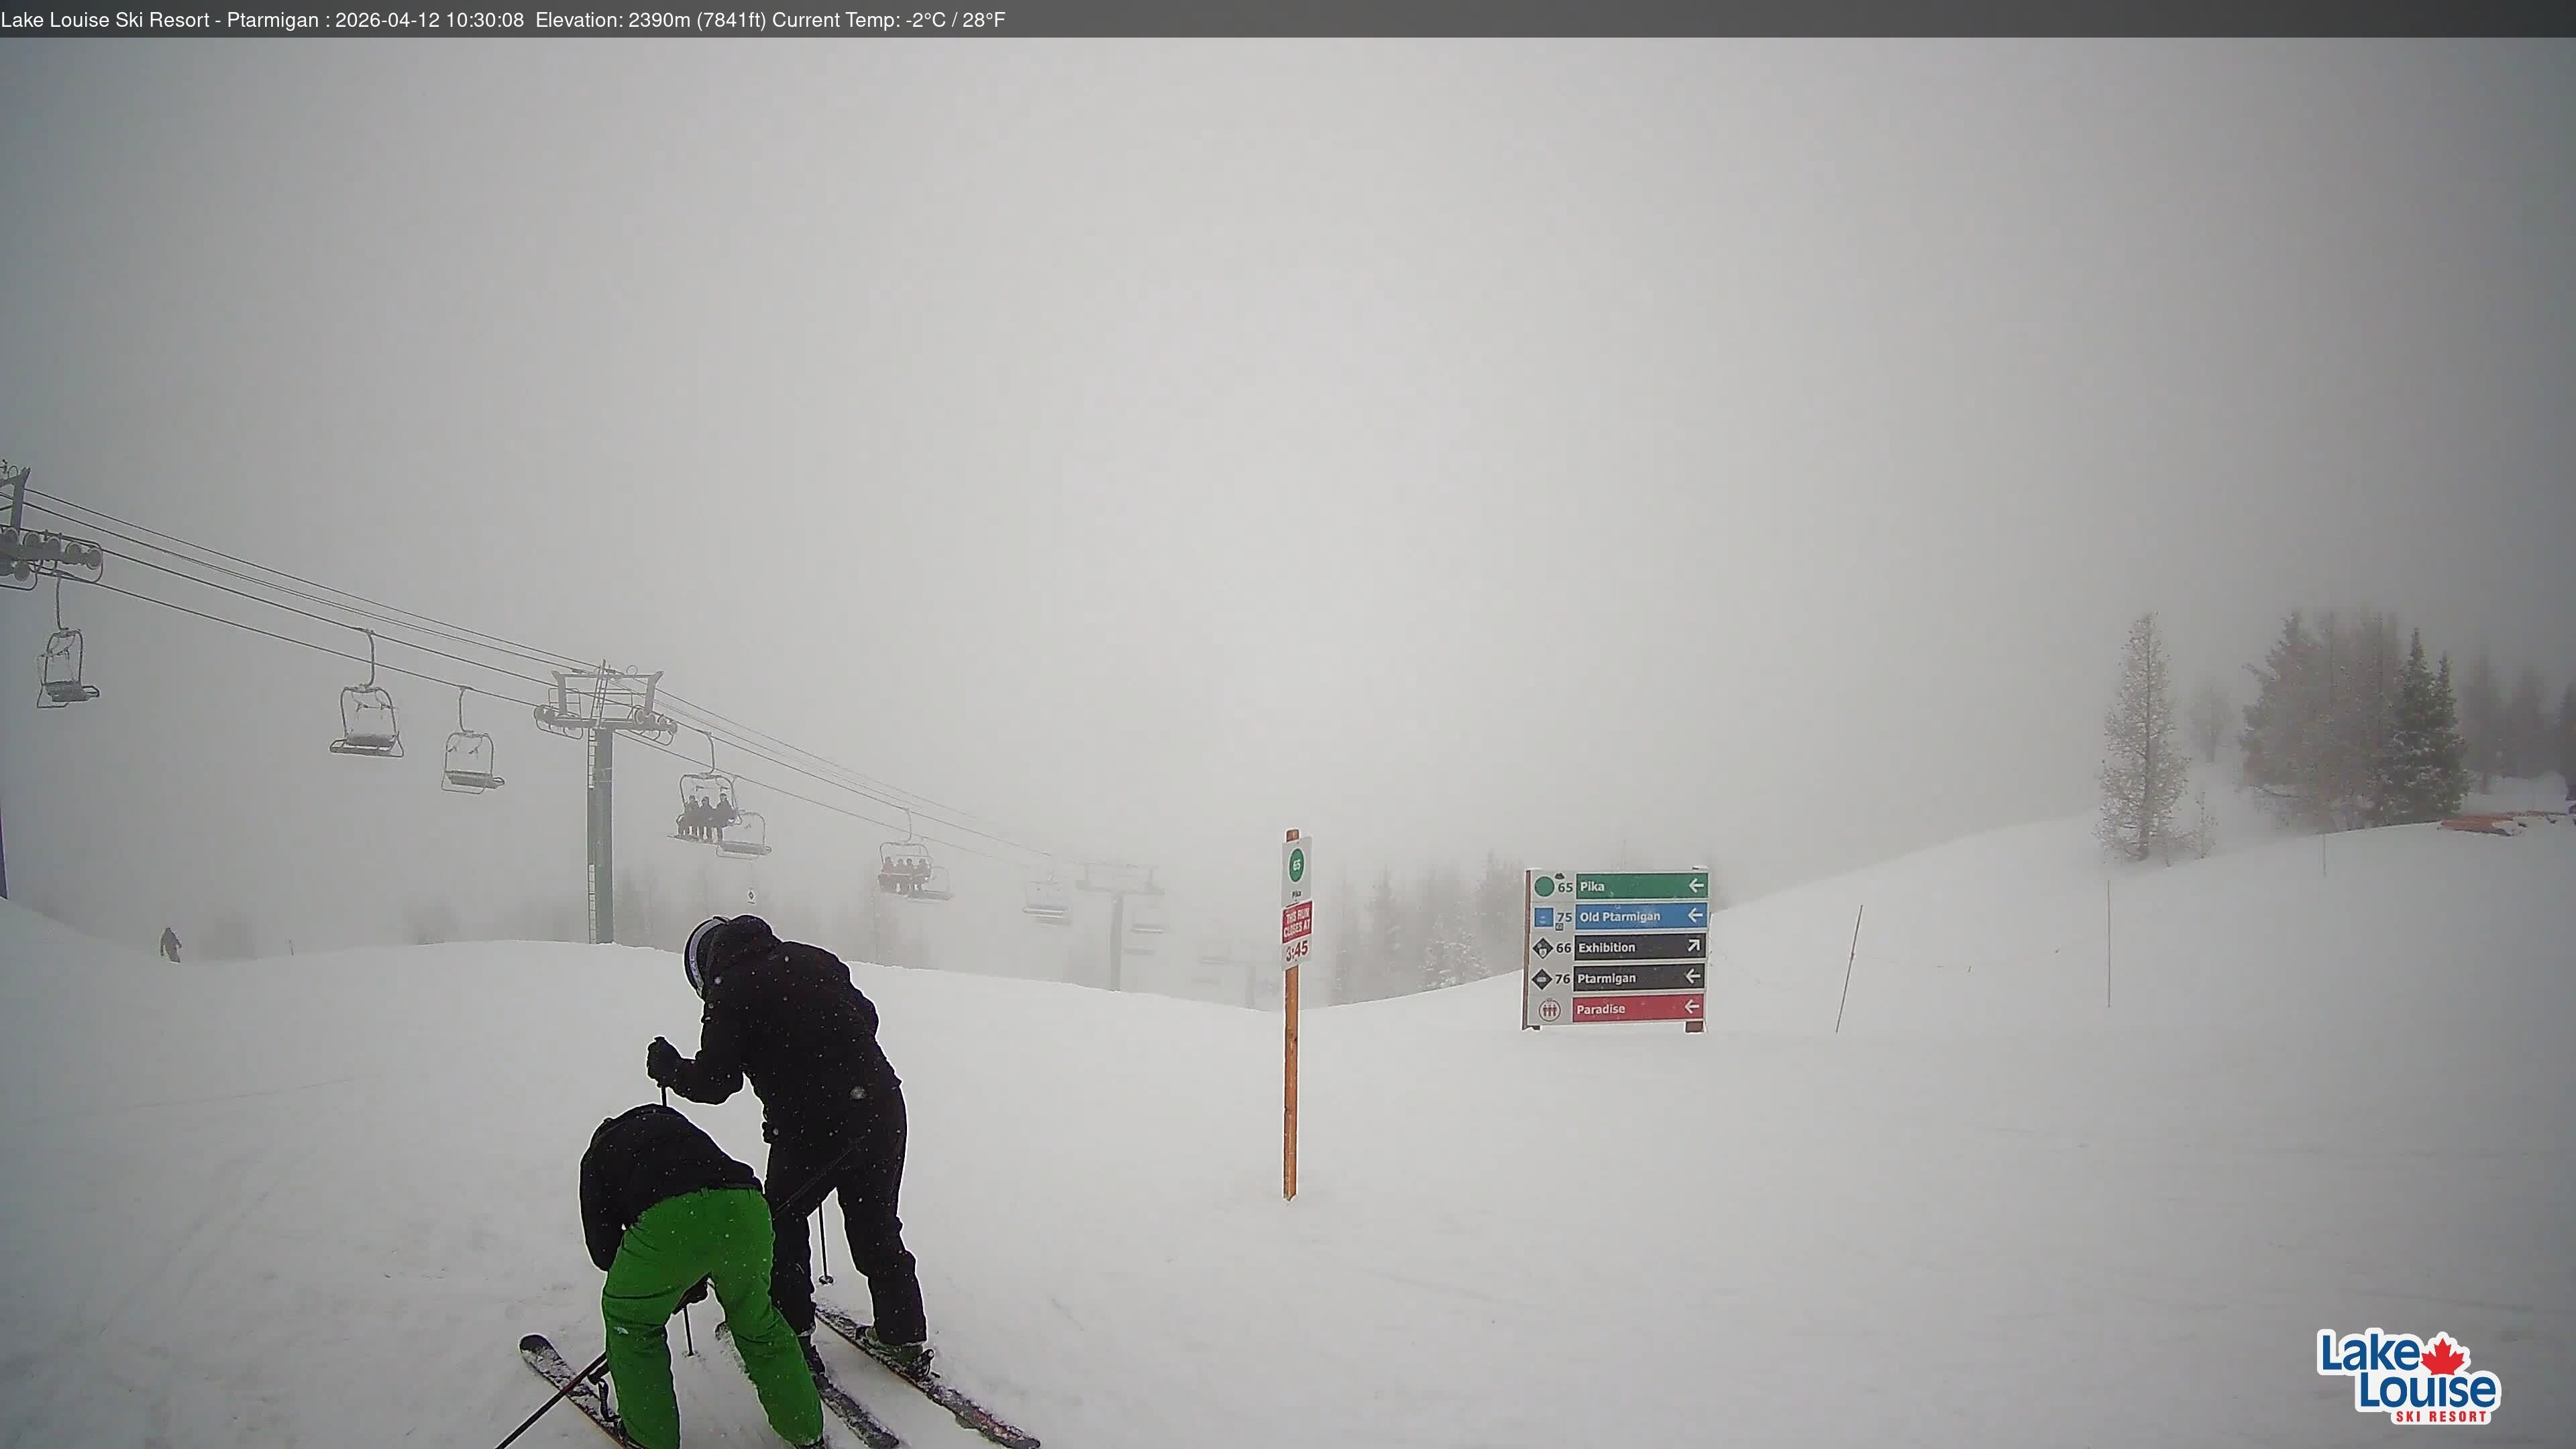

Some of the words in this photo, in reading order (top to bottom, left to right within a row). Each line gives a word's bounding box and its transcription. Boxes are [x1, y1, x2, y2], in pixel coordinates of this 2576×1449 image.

[1558, 883, 1573, 892] 65
[1580, 881, 1605, 892] Pika
[1557, 912, 1572, 922] 75
[1580, 912, 1598, 922] Old
[1603, 912, 1660, 923] Ptarmigan
[1303, 919, 1310, 931] AT
[1286, 939, 1308, 961] 3:45
[1556, 943, 1572, 953] 66
[1578, 942, 1635, 953] Exhibition
[1555, 974, 1570, 984] 76
[1578, 973, 1636, 985] Ptarmigan
[1576, 1004, 1626, 1015] Paradise
